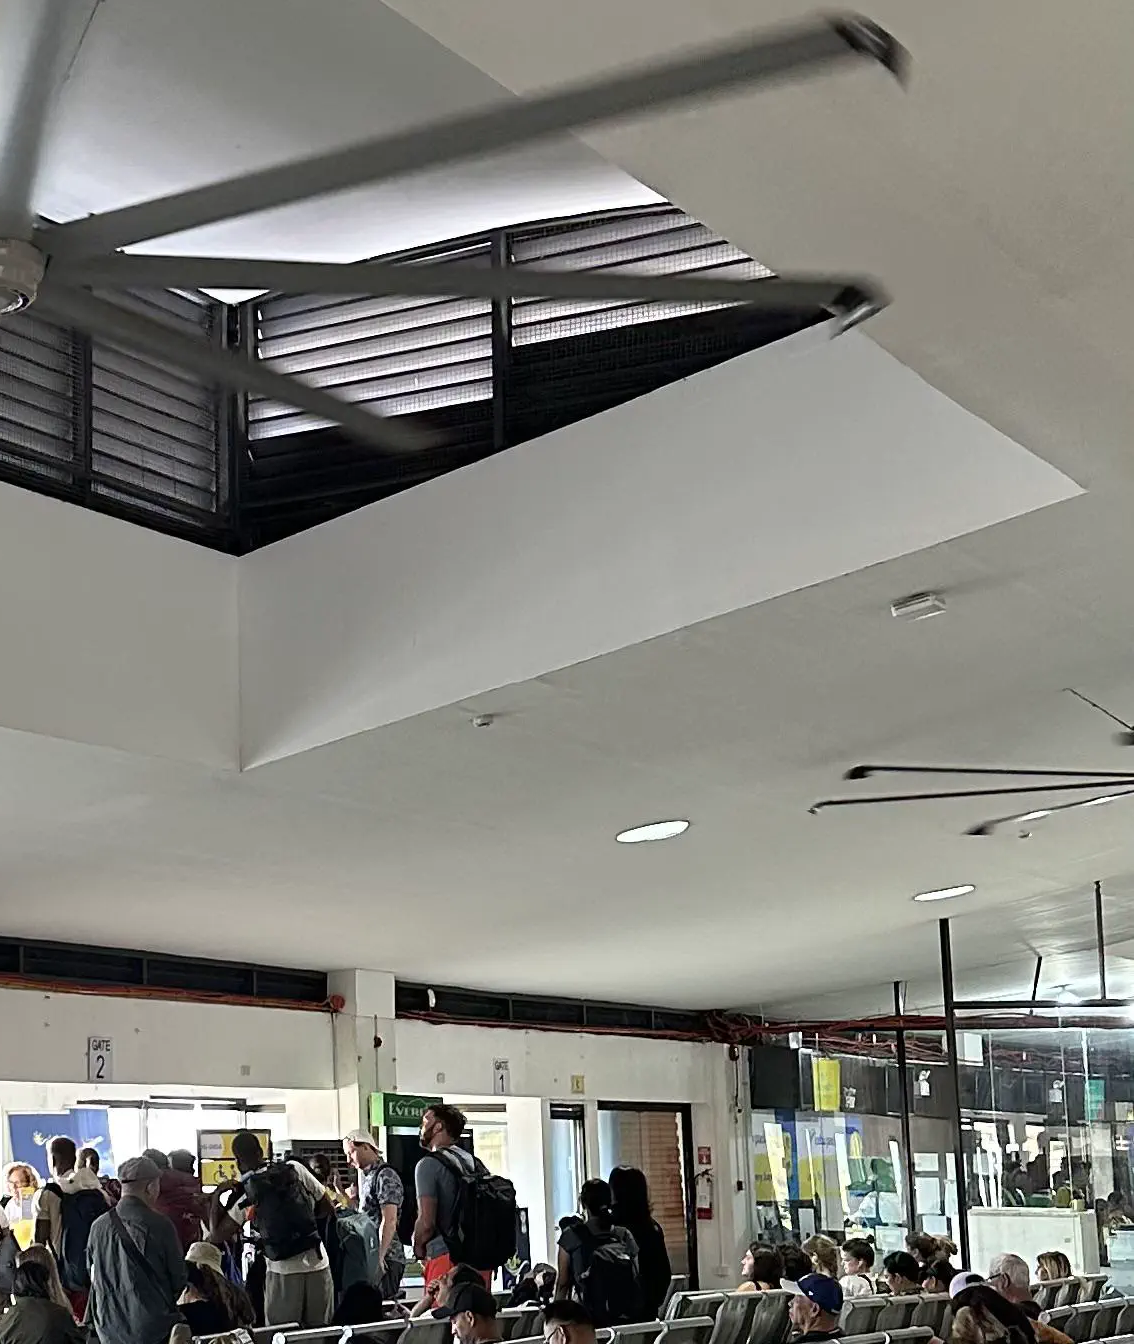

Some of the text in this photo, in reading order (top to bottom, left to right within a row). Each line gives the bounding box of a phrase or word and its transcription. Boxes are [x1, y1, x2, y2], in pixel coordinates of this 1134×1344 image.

[92, 1039, 110, 1052] GATE
[96, 1054, 105, 1079] 2
[499, 1074, 505, 1093] 1
